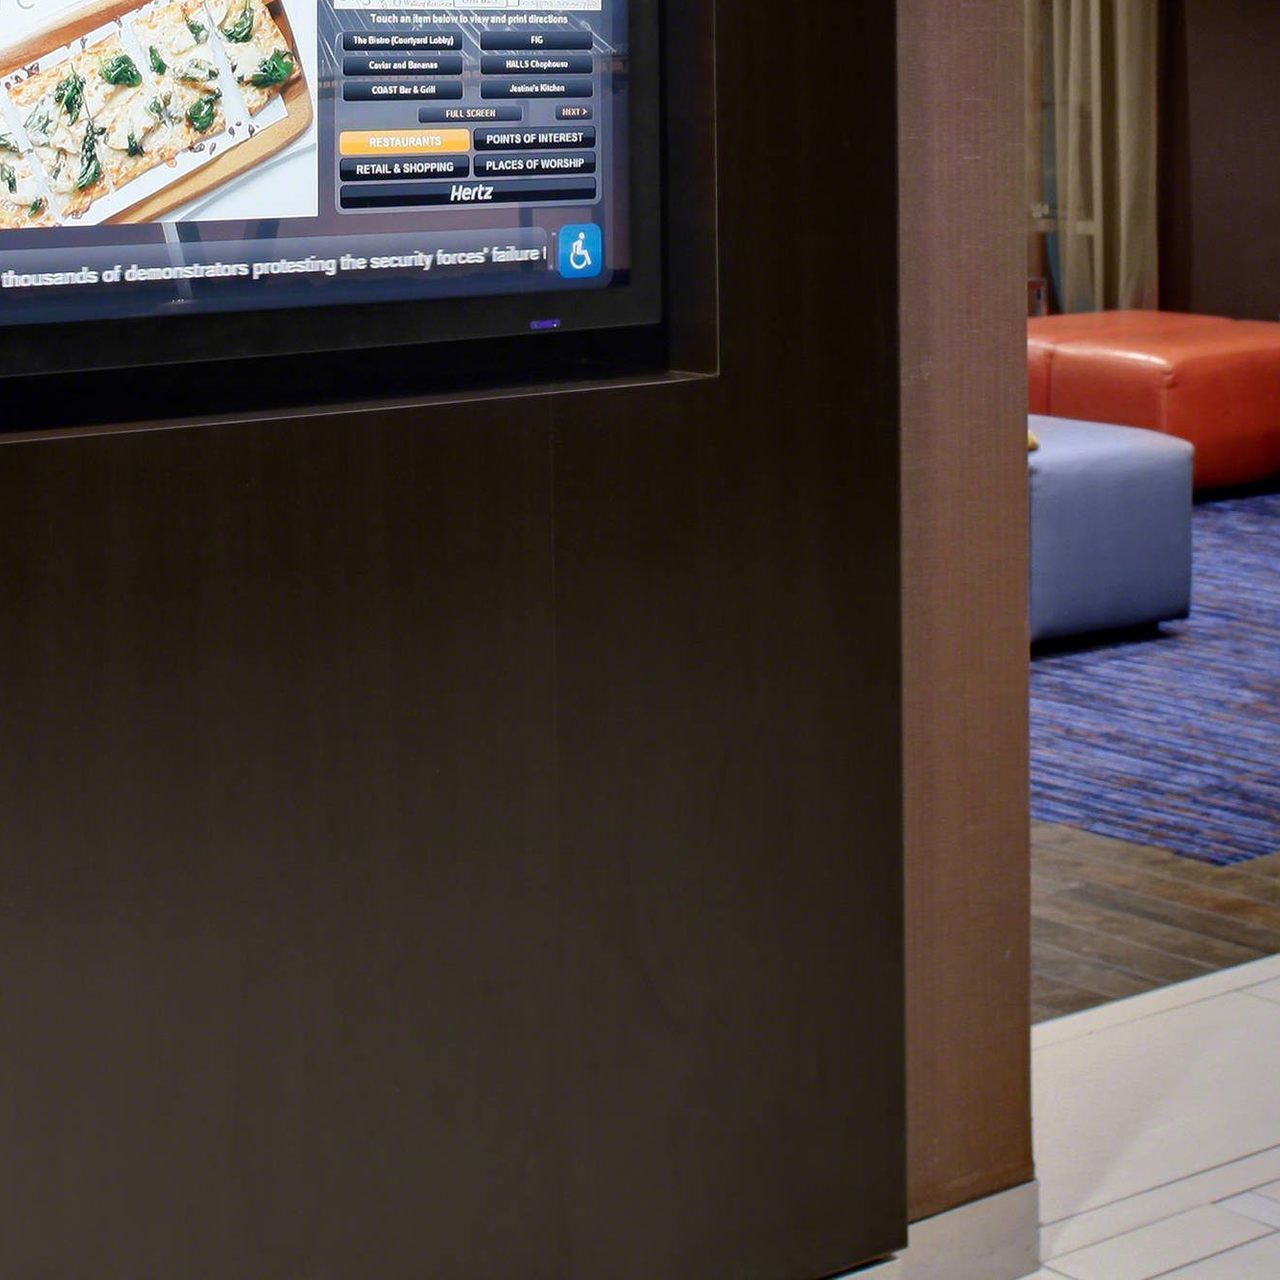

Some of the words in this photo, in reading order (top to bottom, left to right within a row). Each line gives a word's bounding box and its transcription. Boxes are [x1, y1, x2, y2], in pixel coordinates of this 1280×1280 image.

[370, 14, 398, 23] Touch
[400, 15, 411, 23] an
[412, 14, 431, 23] item
[433, 14, 459, 23] below
[469, 14, 489, 24] view
[490, 15, 506, 23] and
[508, 14, 527, 25] print
[528, 14, 568, 24] directions
[353, 36, 367, 45] The
[531, 35, 543, 44] FIG
[506, 60, 529, 68] HALLS
[371, 86, 398, 94] COAST
[399, 86, 411, 94] Bar
[420, 85, 436, 94] Grill
[446, 109, 463, 118] FULL
[466, 109, 496, 118] SCREEN
[369, 136, 441, 147] RESTAURANTS
[486, 134, 521, 144] POINTS
[523, 133, 537, 143] OF
[539, 132, 583, 142] INTEREST
[356, 164, 391, 175] RETAIL
[393, 163, 401, 173] &
[403, 162, 454, 173] SHOPPING
[486, 159, 524, 171] PLACES
[526, 159, 539, 169] OF
[540, 158, 584, 169] WORSHIP
[450, 184, 494, 201] Hertz
[1, 266, 98, 288] thousands
[102, 264, 123, 283] of
[124, 262, 249, 283] demonstrators
[252, 255, 337, 279] protesting
[340, 252, 368, 271] the
[369, 249, 432, 271] security
[491, 245, 539, 264] failure
